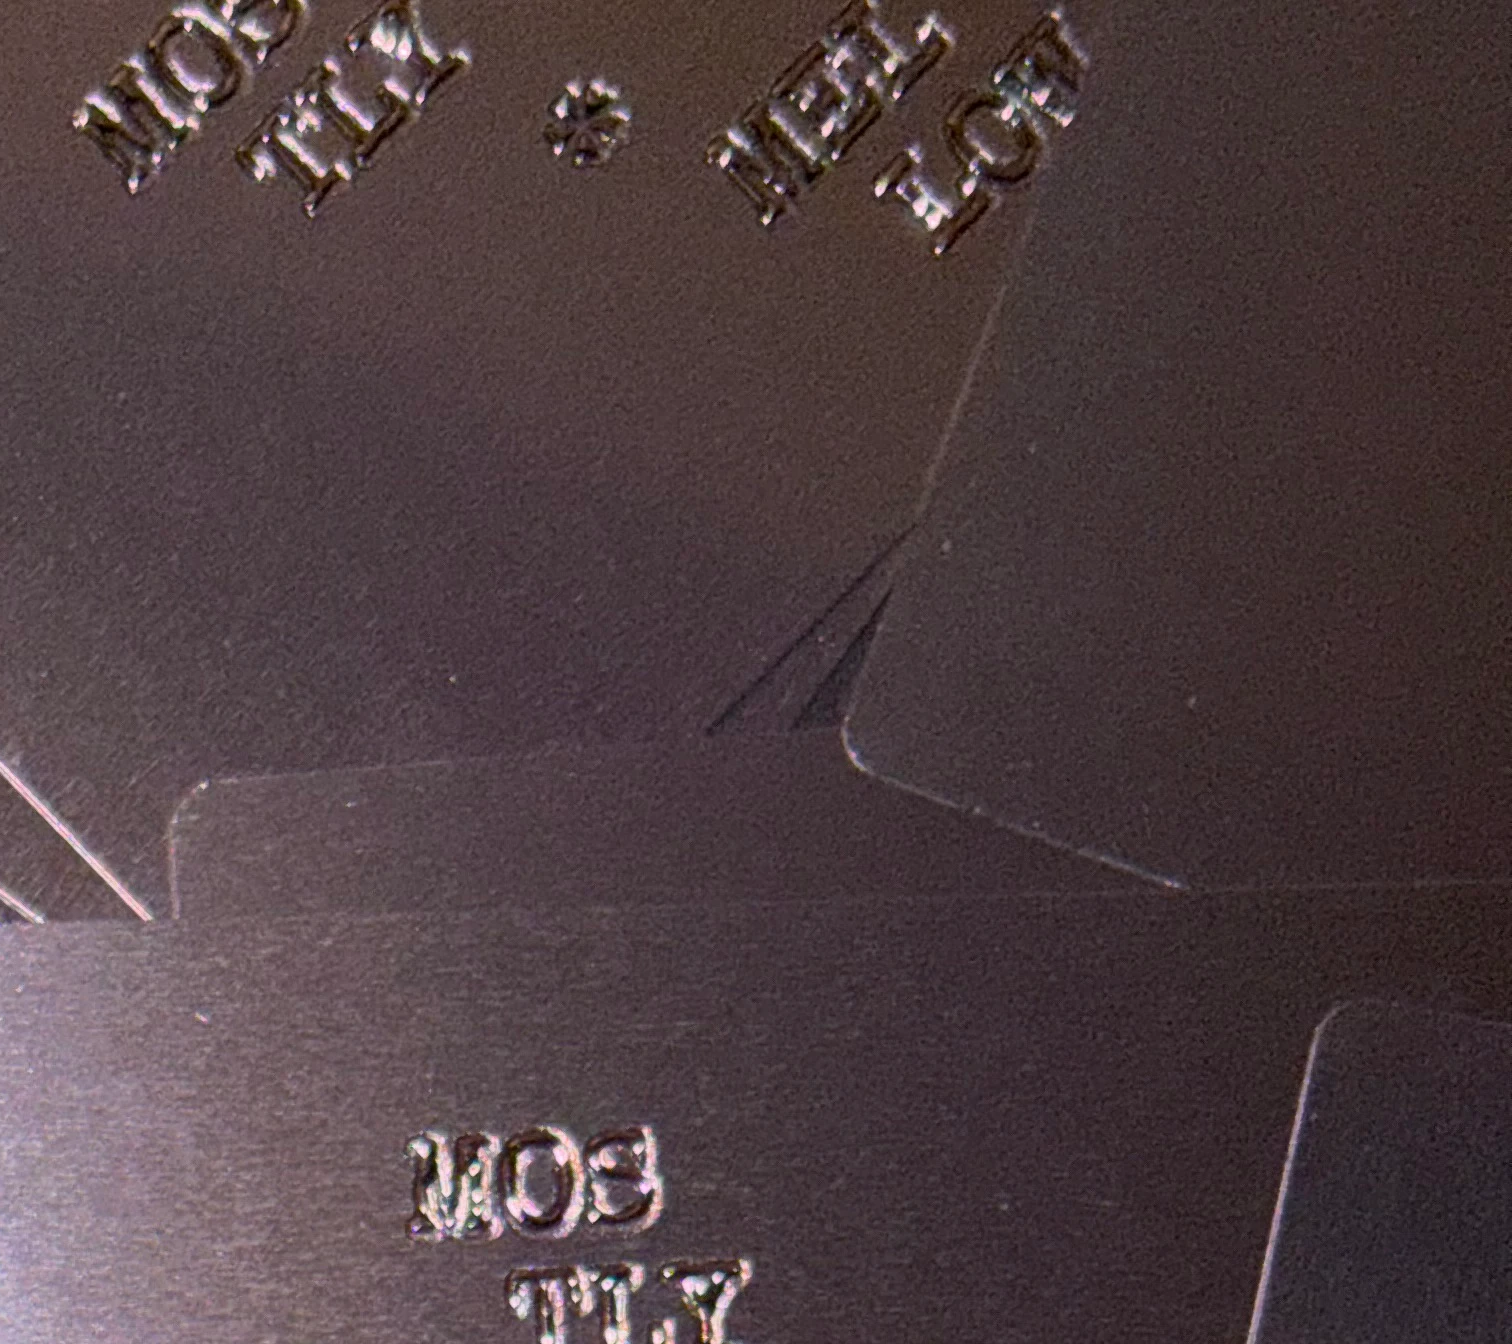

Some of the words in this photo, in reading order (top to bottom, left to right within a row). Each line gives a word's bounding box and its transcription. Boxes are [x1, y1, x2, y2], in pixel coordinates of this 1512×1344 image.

[233, 0, 472, 217] TLY
[704, 0, 955, 226] MEL
[405, 1125, 665, 1240] MOS
